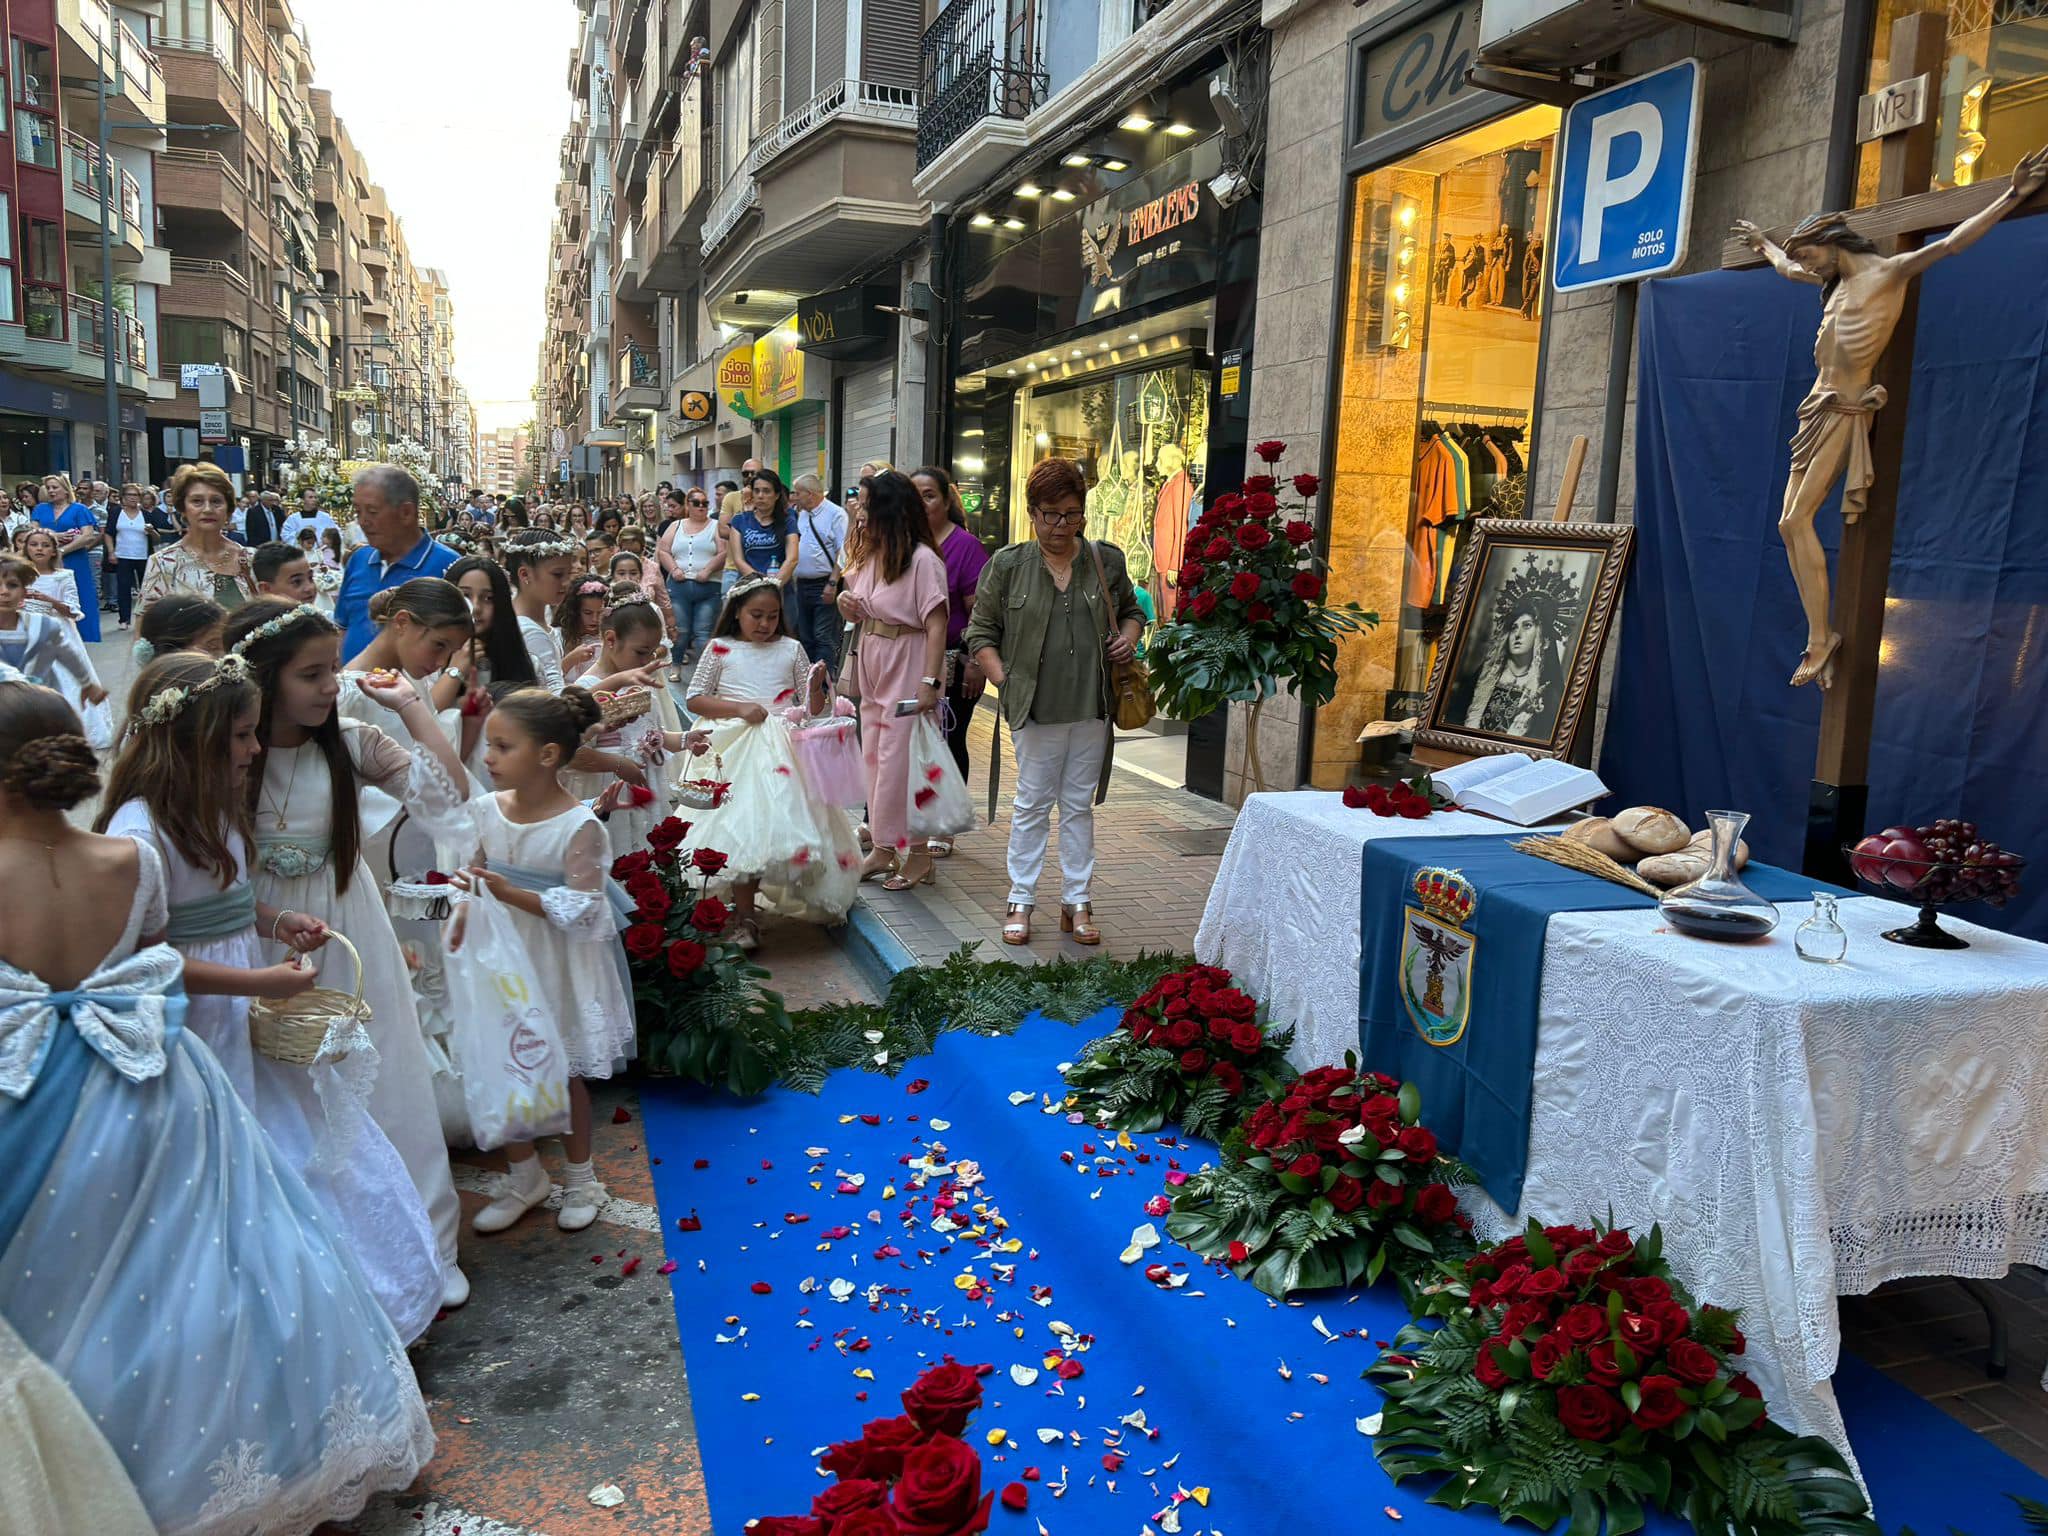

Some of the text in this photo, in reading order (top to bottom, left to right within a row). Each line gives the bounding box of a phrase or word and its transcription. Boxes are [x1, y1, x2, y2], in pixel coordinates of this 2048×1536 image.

[1869, 89, 1917, 132] INRI
[1578, 101, 1664, 265] P
[1127, 180, 1200, 247] EMBLEMS
[1638, 228, 1664, 245] SOLO
[1631, 242, 1666, 260] MOTOS
[803, 310, 836, 342] NOA
[727, 359, 750, 372] don
[721, 371, 751, 384] Dino
[561, 462, 568, 480] P
